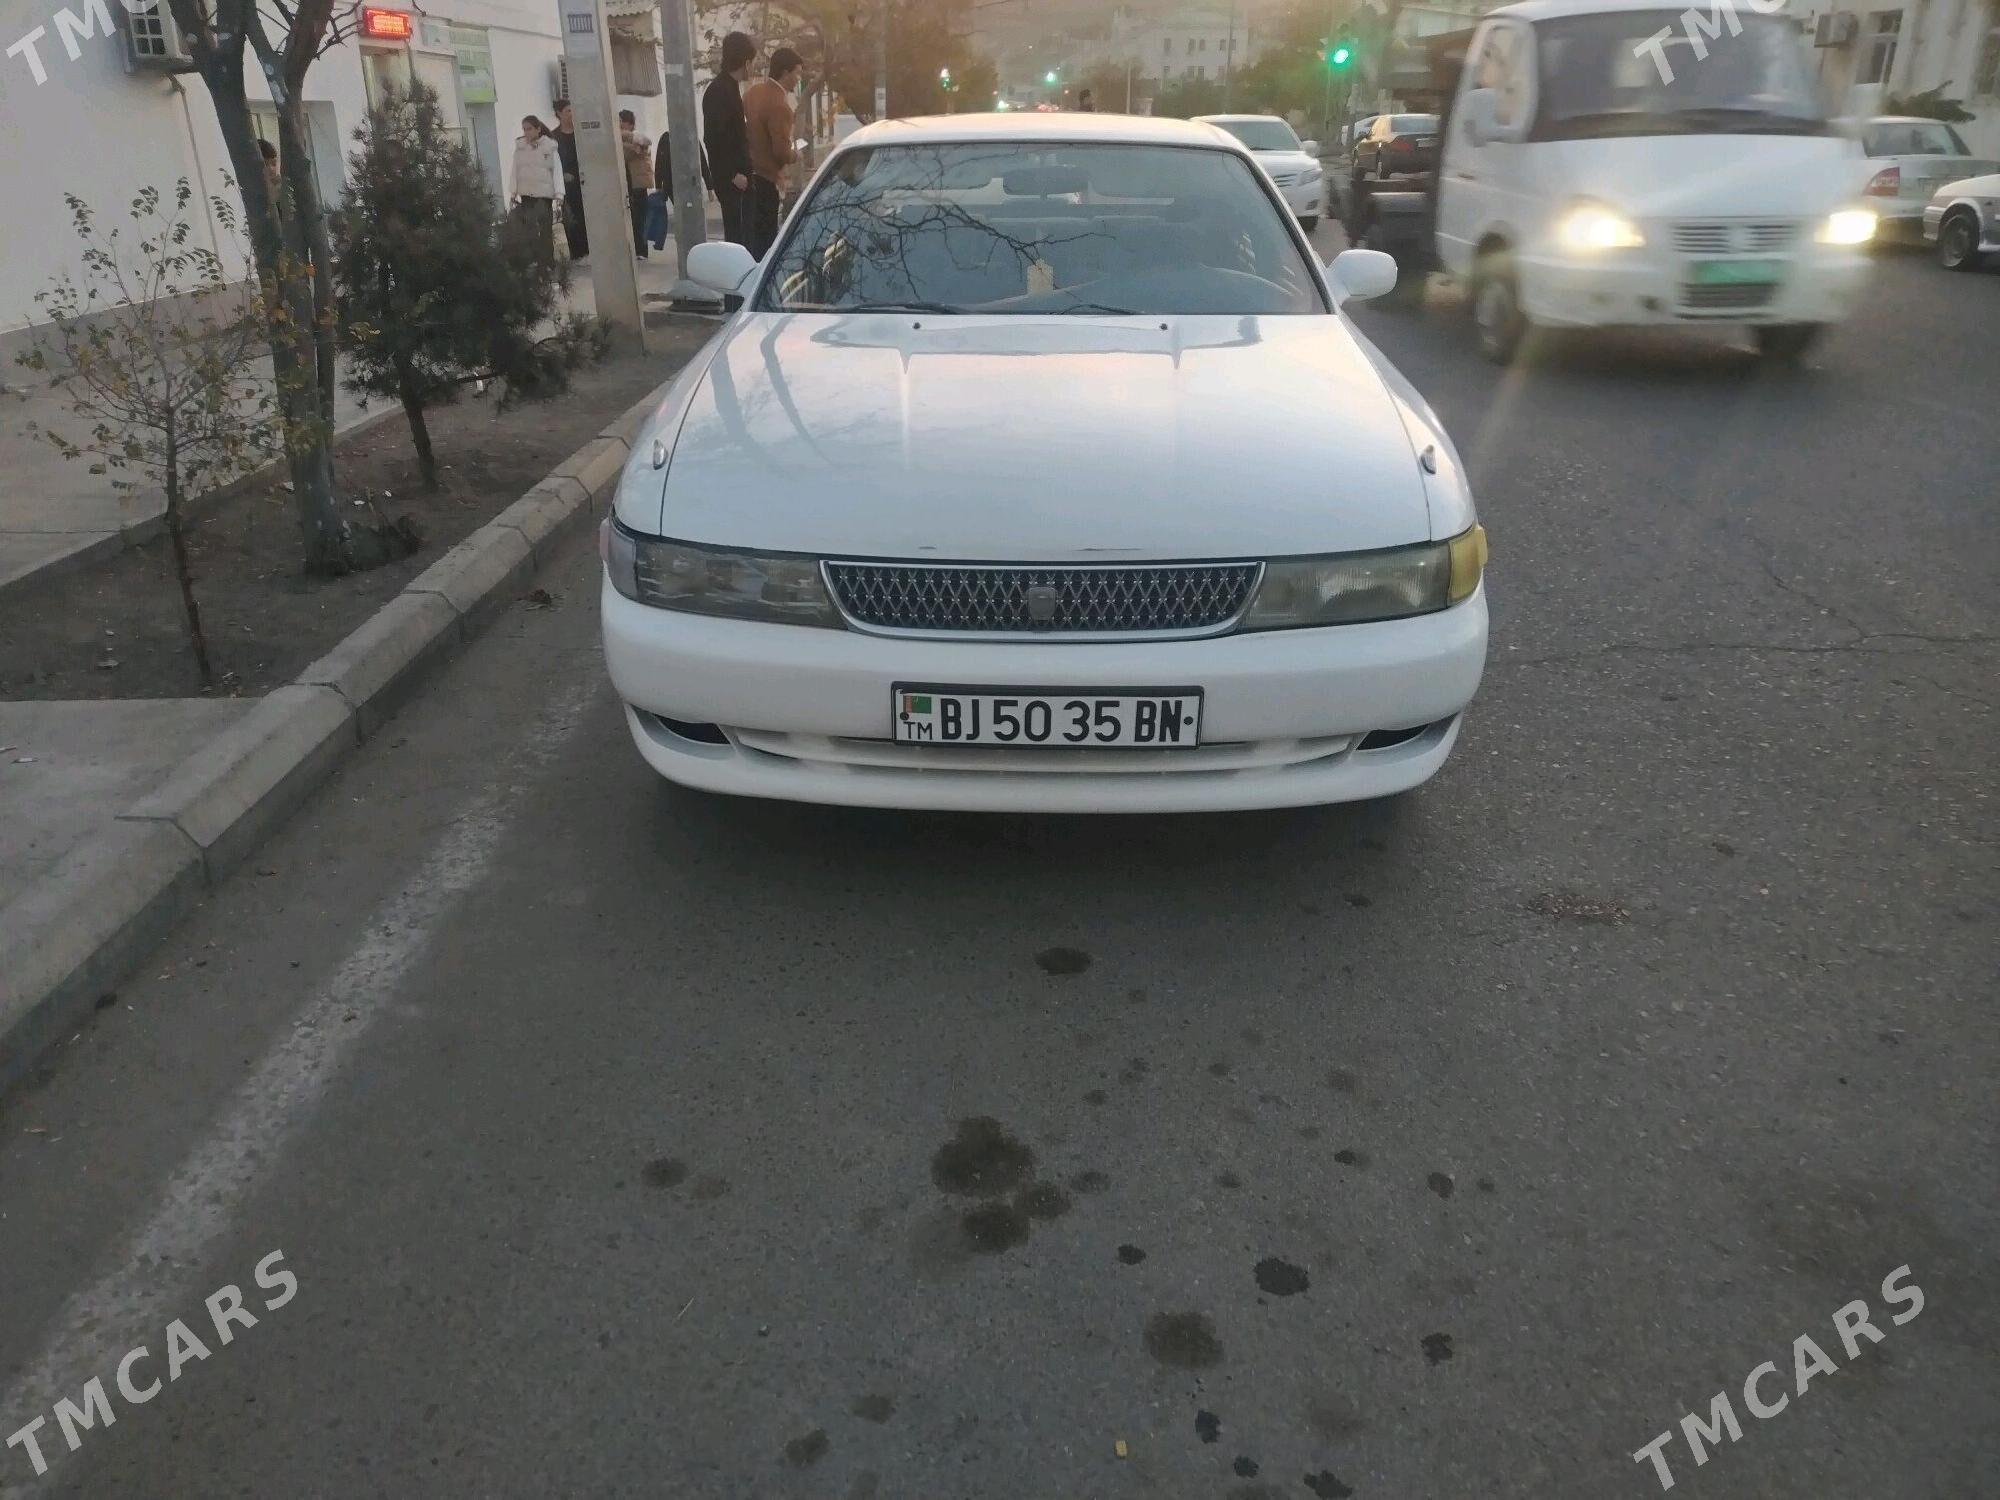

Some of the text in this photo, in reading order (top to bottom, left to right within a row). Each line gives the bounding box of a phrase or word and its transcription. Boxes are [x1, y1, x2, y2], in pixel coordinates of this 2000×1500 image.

[903, 720, 933, 740] TM
[940, 697, 1183, 743] BJ 50 35 BN
